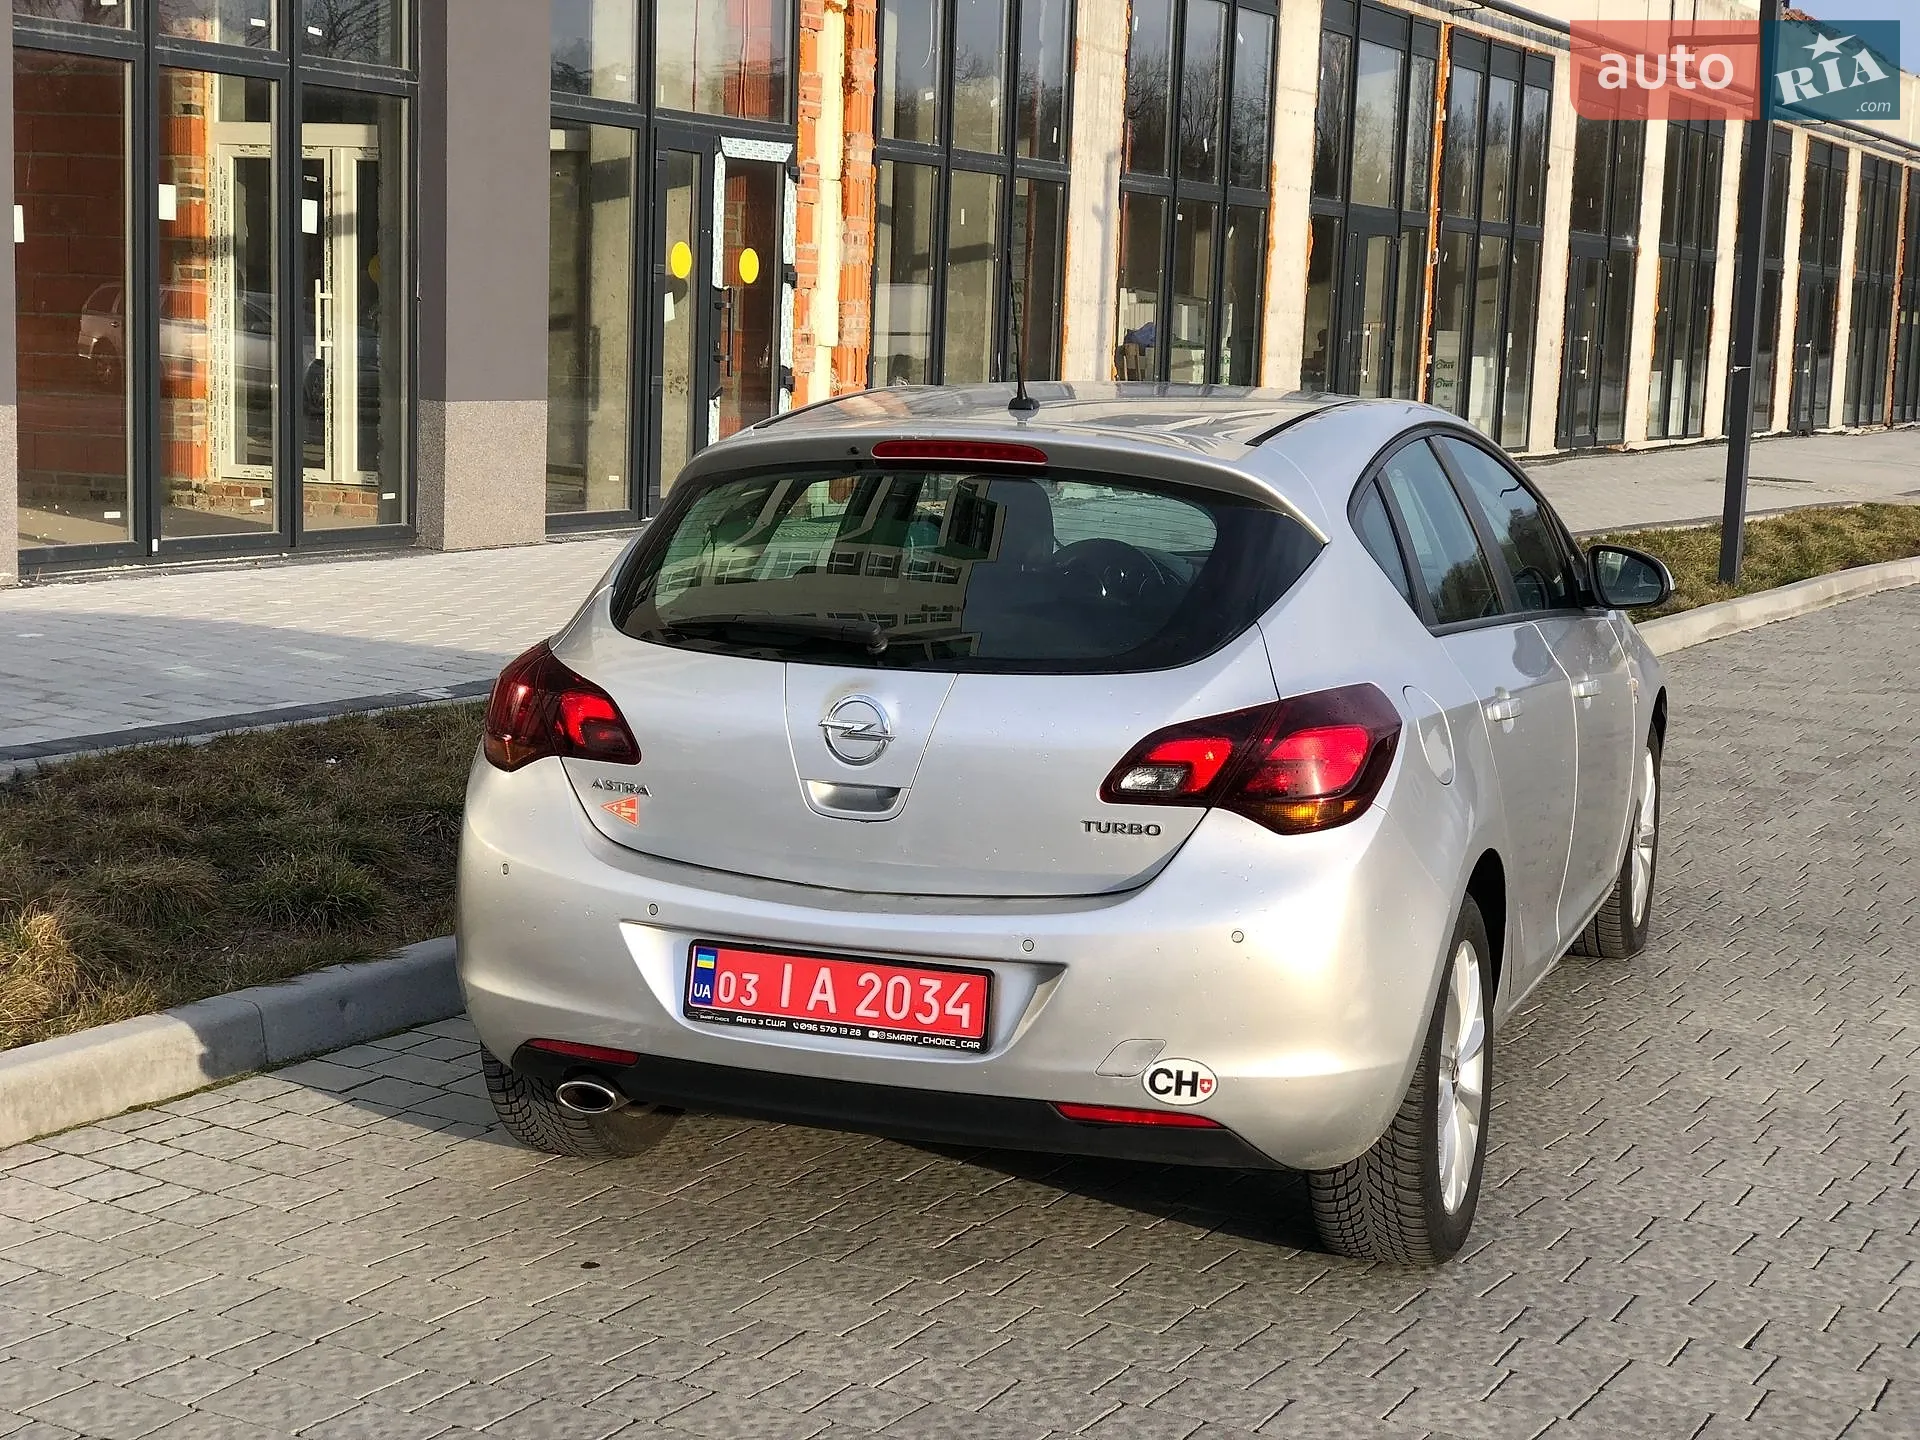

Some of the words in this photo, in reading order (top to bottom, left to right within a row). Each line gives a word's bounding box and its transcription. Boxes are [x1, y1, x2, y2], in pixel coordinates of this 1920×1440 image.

[592, 777, 653, 798] ASTRA
[1080, 819, 1162, 837] TURBO
[693, 982, 712, 1000] UA
[717, 970, 761, 1007] 03
[854, 971, 972, 1029] 2034
[736, 1015, 757, 1025] Авто
[765, 1018, 787, 1028] США
[799, 1023, 818, 1032] 096
[819, 1025, 838, 1034] 570
[839, 1027, 848, 1035] 13
[849, 1028, 862, 1037] 28
[1149, 1067, 1199, 1098] CH
